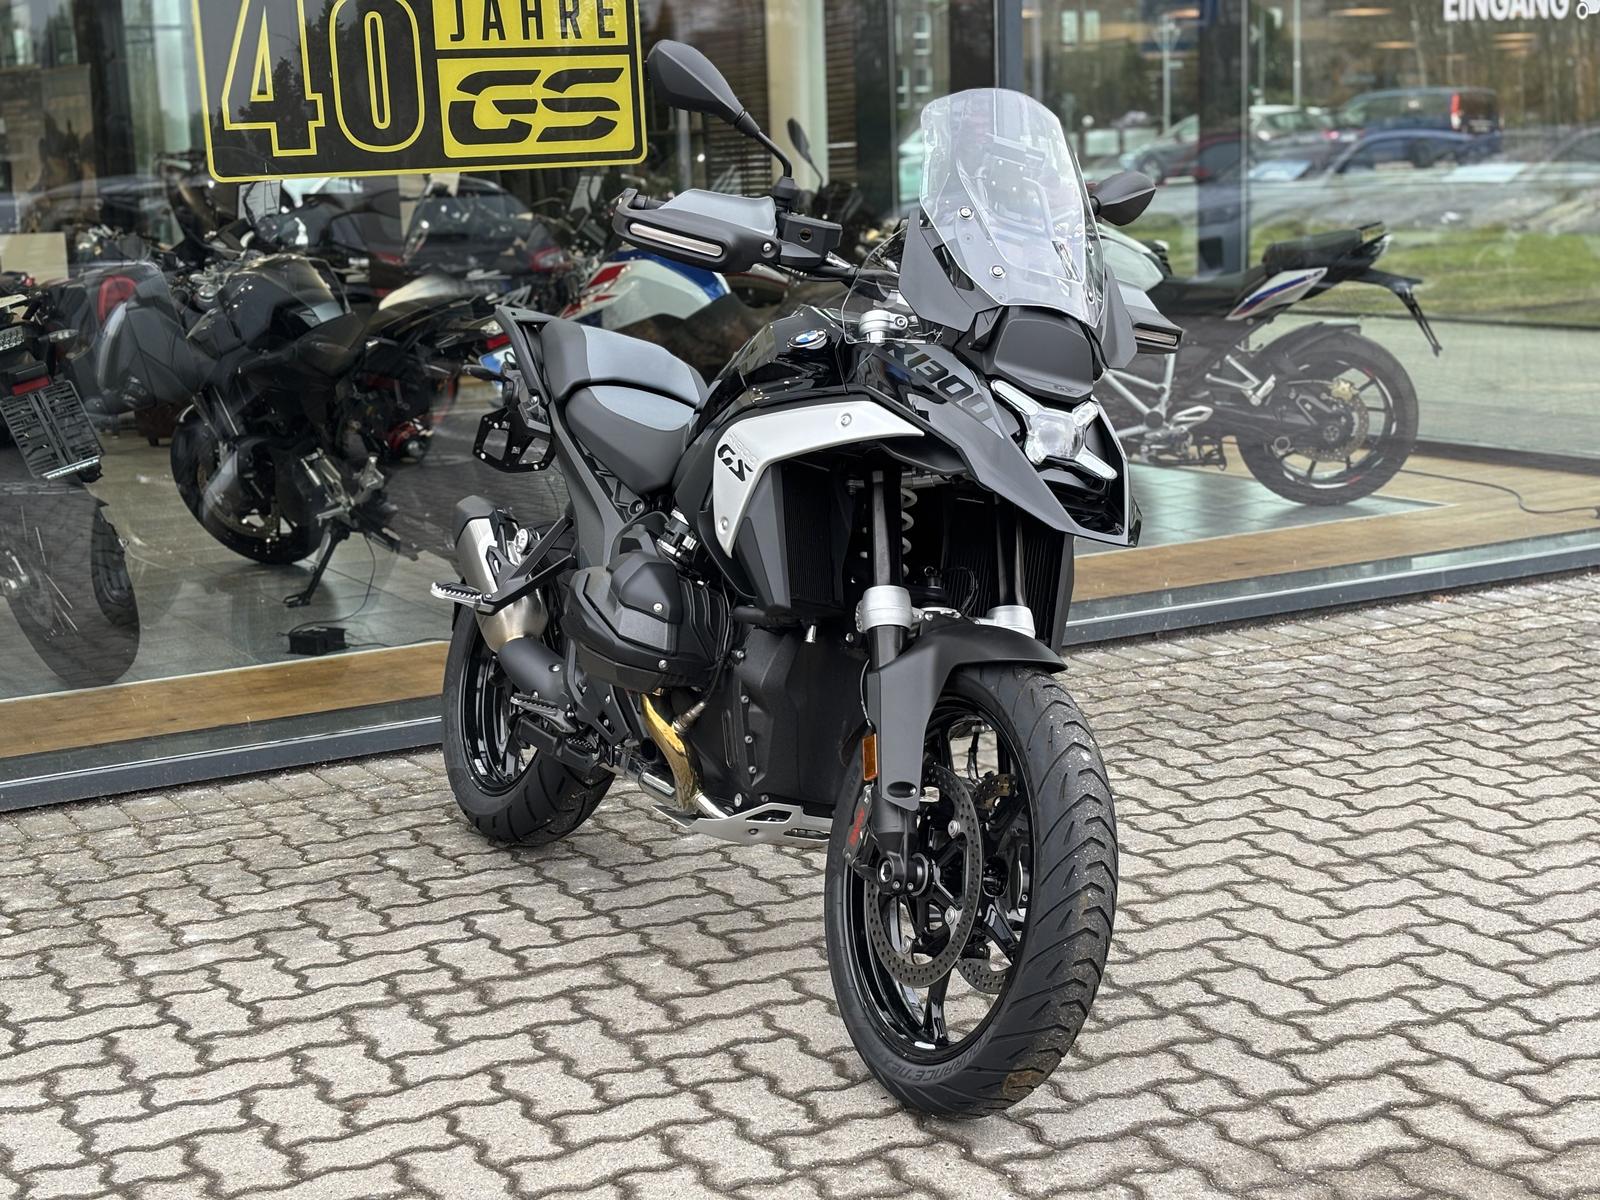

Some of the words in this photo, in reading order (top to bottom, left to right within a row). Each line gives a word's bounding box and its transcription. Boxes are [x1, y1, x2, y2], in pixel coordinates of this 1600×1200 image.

[449, 0, 616, 42] JAHRE
[1443, 0, 1570, 21] EINGANG
[221, 0, 425, 157] 40
[447, 67, 625, 146] GS
[717, 443, 754, 482] GS
